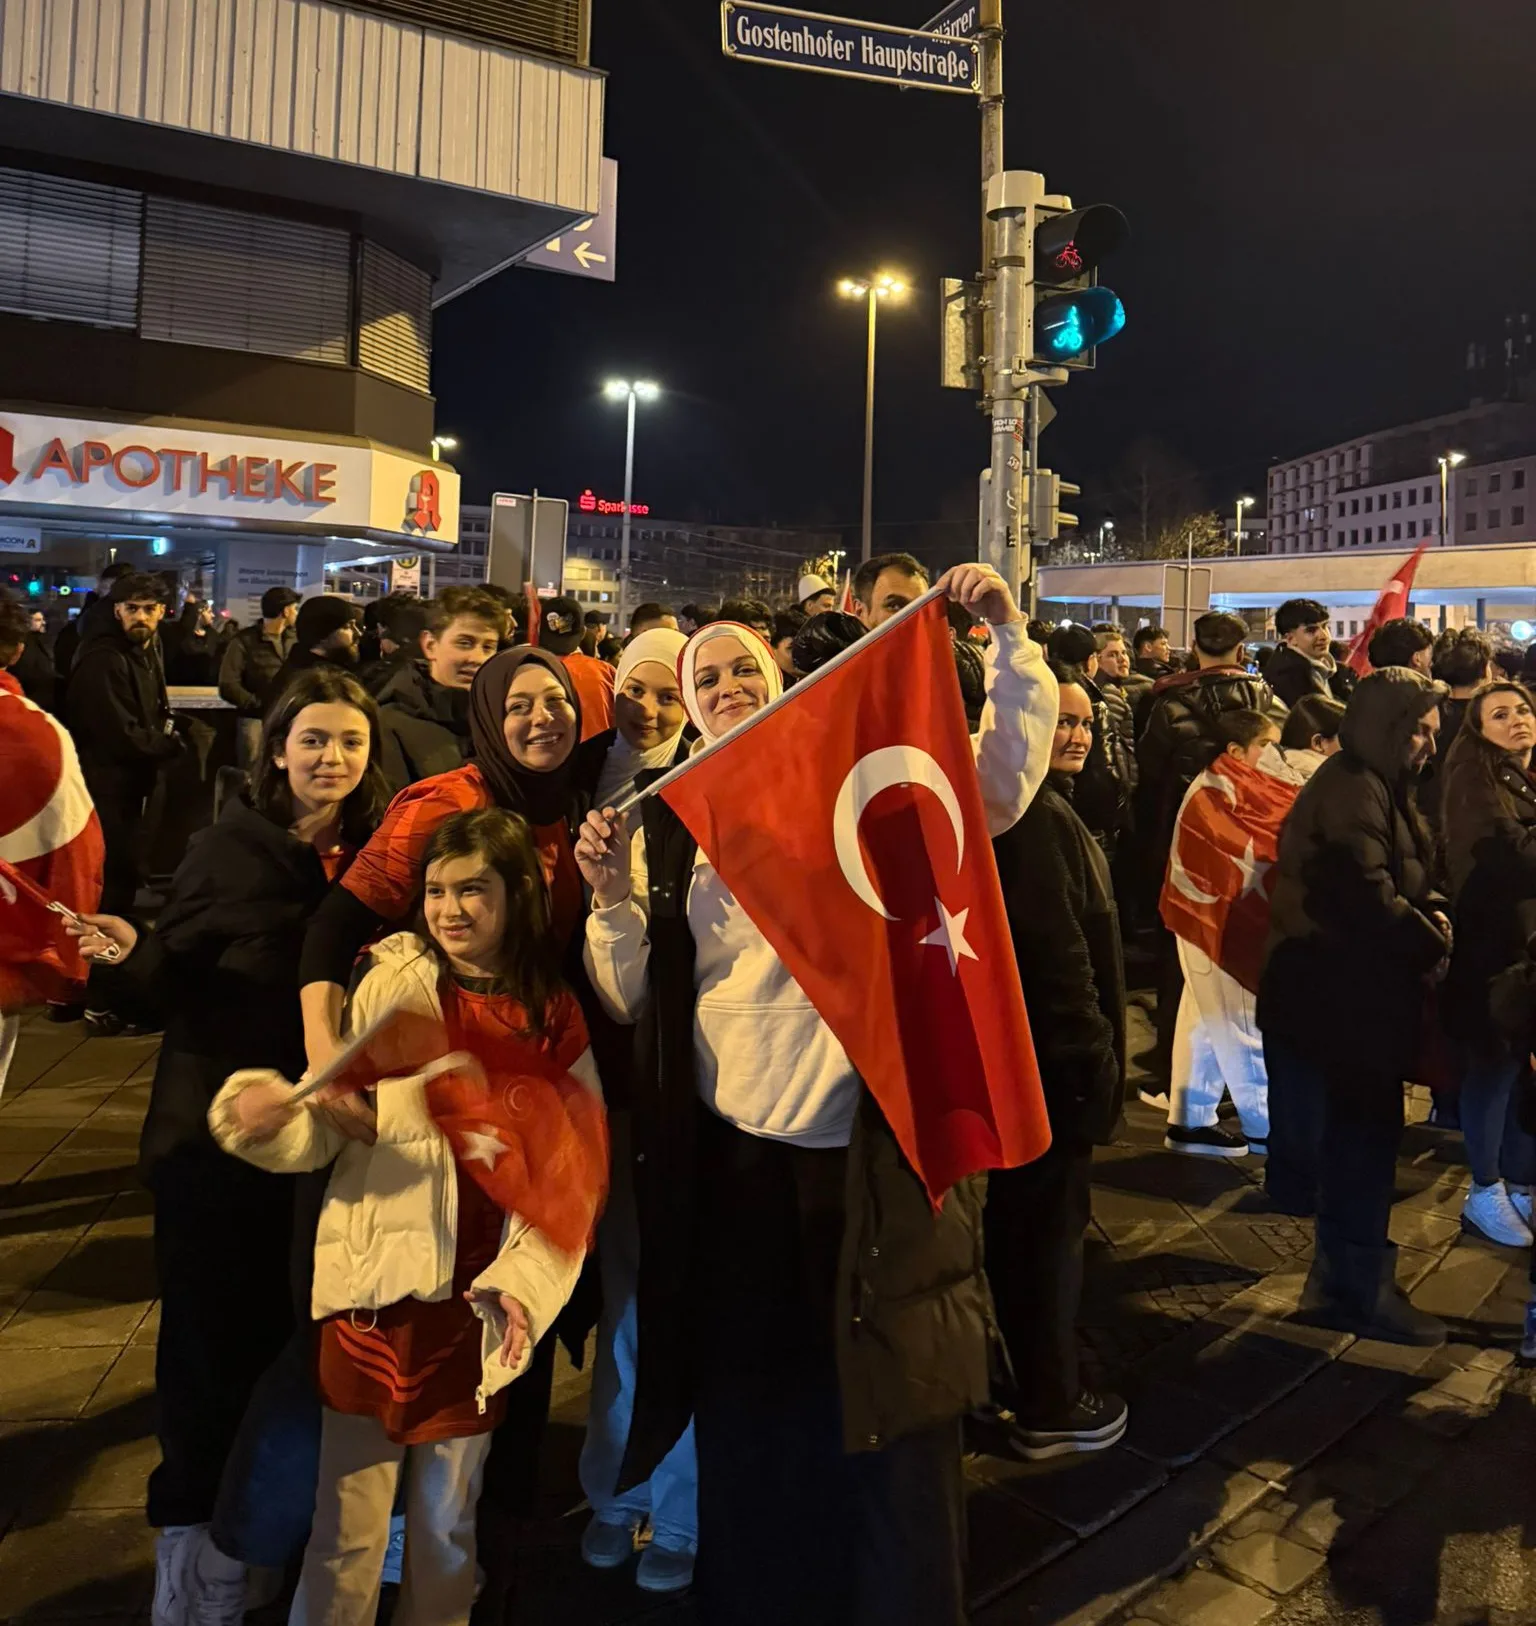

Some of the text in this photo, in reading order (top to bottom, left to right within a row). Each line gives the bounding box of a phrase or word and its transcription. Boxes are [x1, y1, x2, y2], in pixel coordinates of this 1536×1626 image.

[736, 15, 969, 82] Gostenhofer Hauptstraße
[33, 437, 337, 502] APOTHEKE
